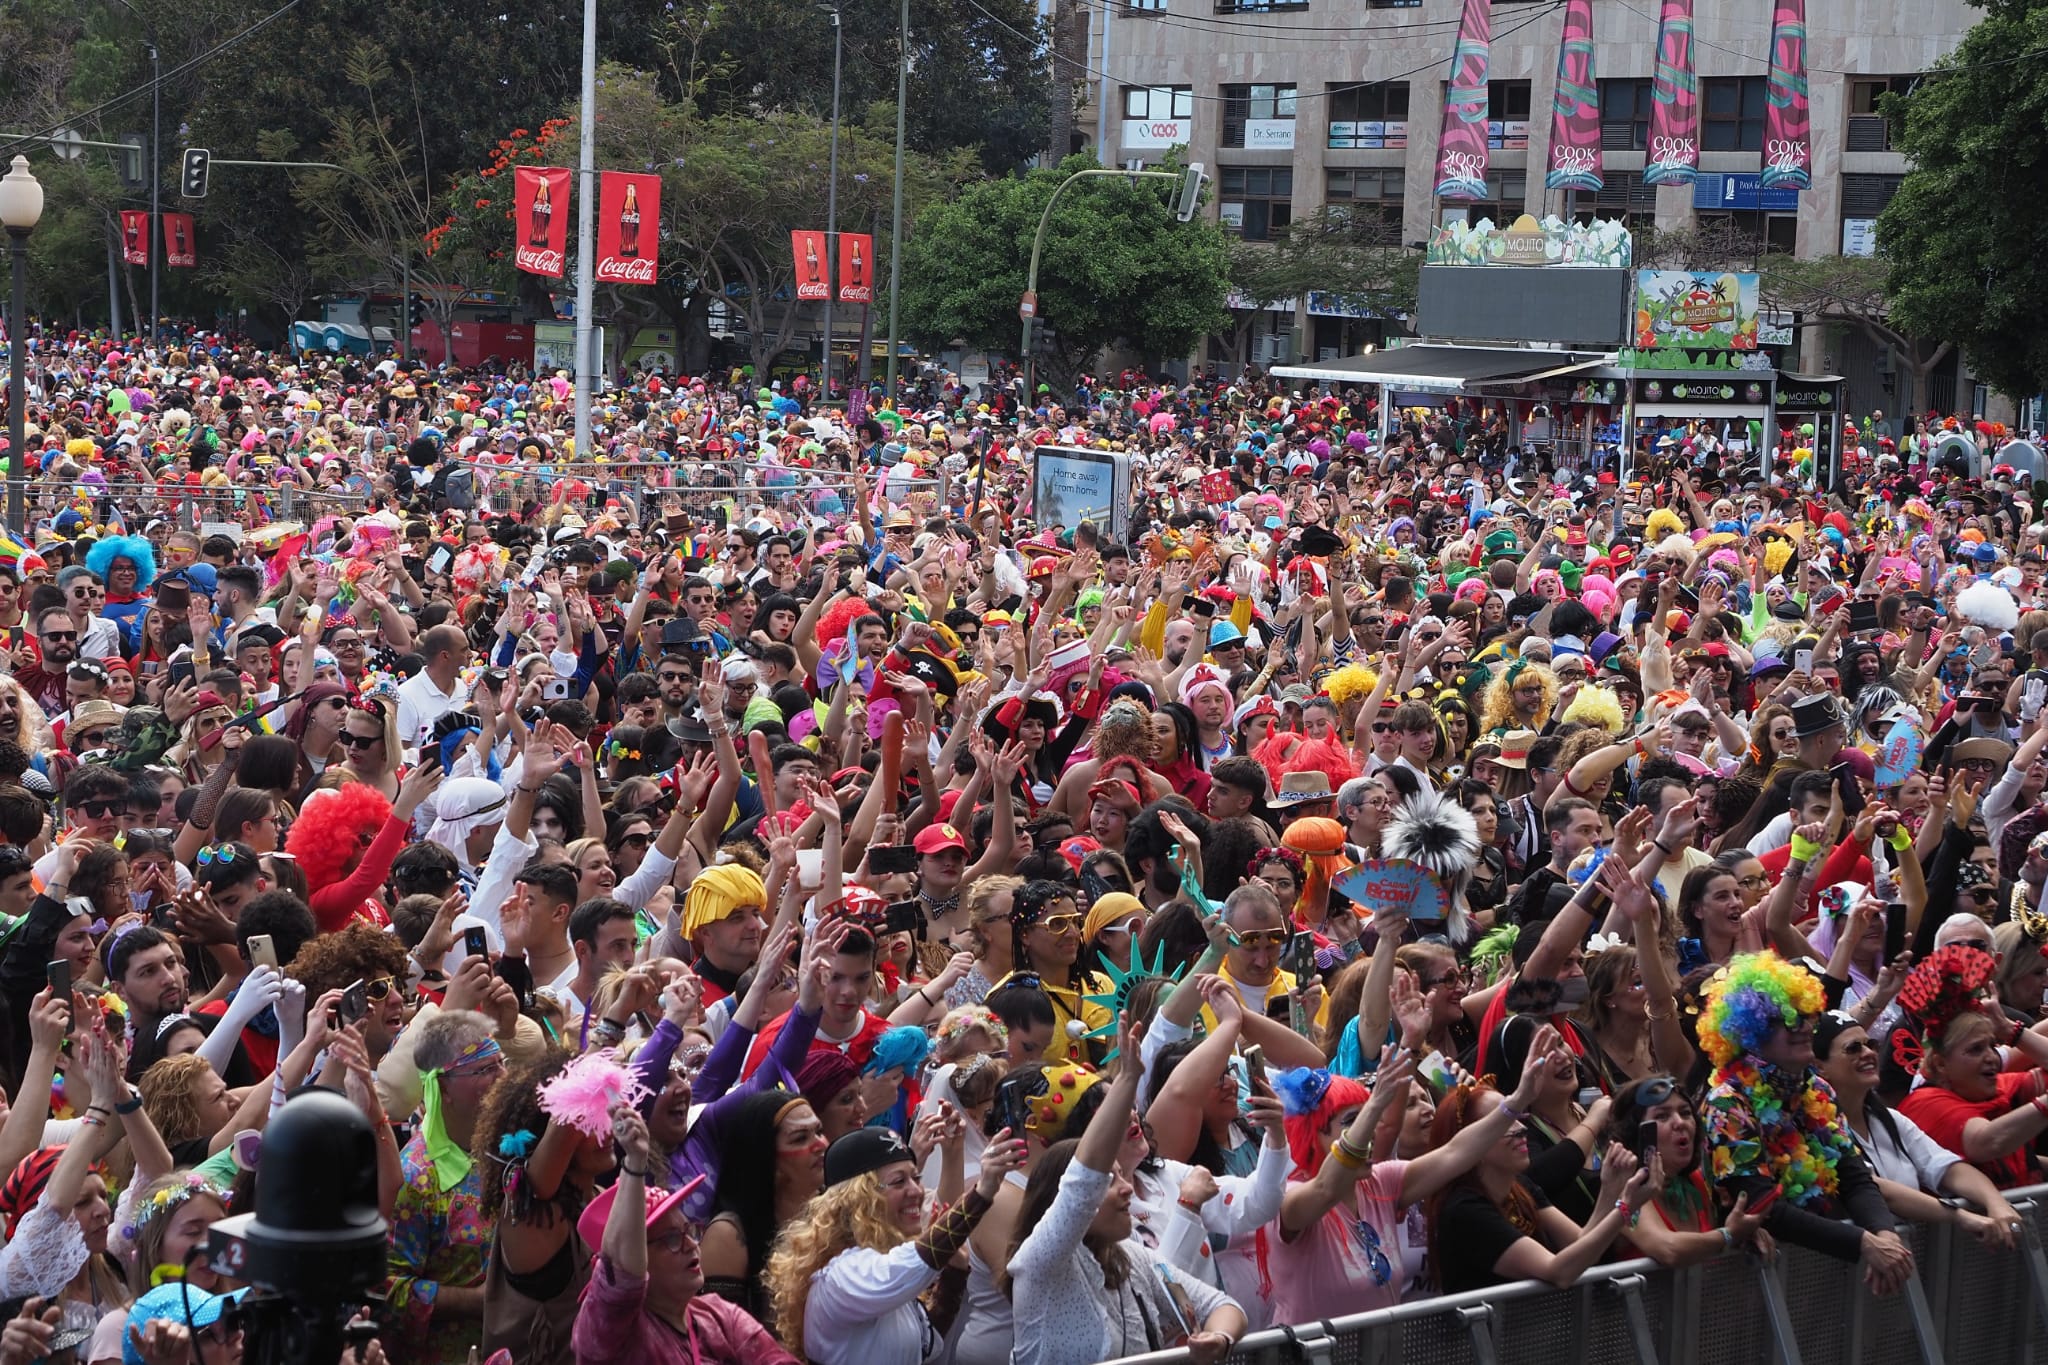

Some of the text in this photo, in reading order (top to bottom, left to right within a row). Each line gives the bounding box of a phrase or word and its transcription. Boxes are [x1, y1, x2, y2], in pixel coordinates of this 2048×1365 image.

[1253, 128, 1291, 138] Dr. Serrano
[1554, 144, 1596, 161] COOK
[1653, 136, 1695, 153] COOK
[1768, 139, 1806, 156] COOK
[1554, 157, 1594, 175] Music
[1652, 149, 1693, 170] Music
[1507, 238, 1544, 252] MOJITO
[516, 245, 563, 274] Coca-Cola
[598, 256, 656, 280] Coca-Cola
[1687, 306, 1717, 317] MOJITO
[1688, 386, 1720, 395] MOJITO
[1788, 392, 1817, 401] MOJITO
[1053, 467, 1100, 484] Home away
[1054, 483, 1098, 496] from home
[231, 1242, 242, 1265] 2
